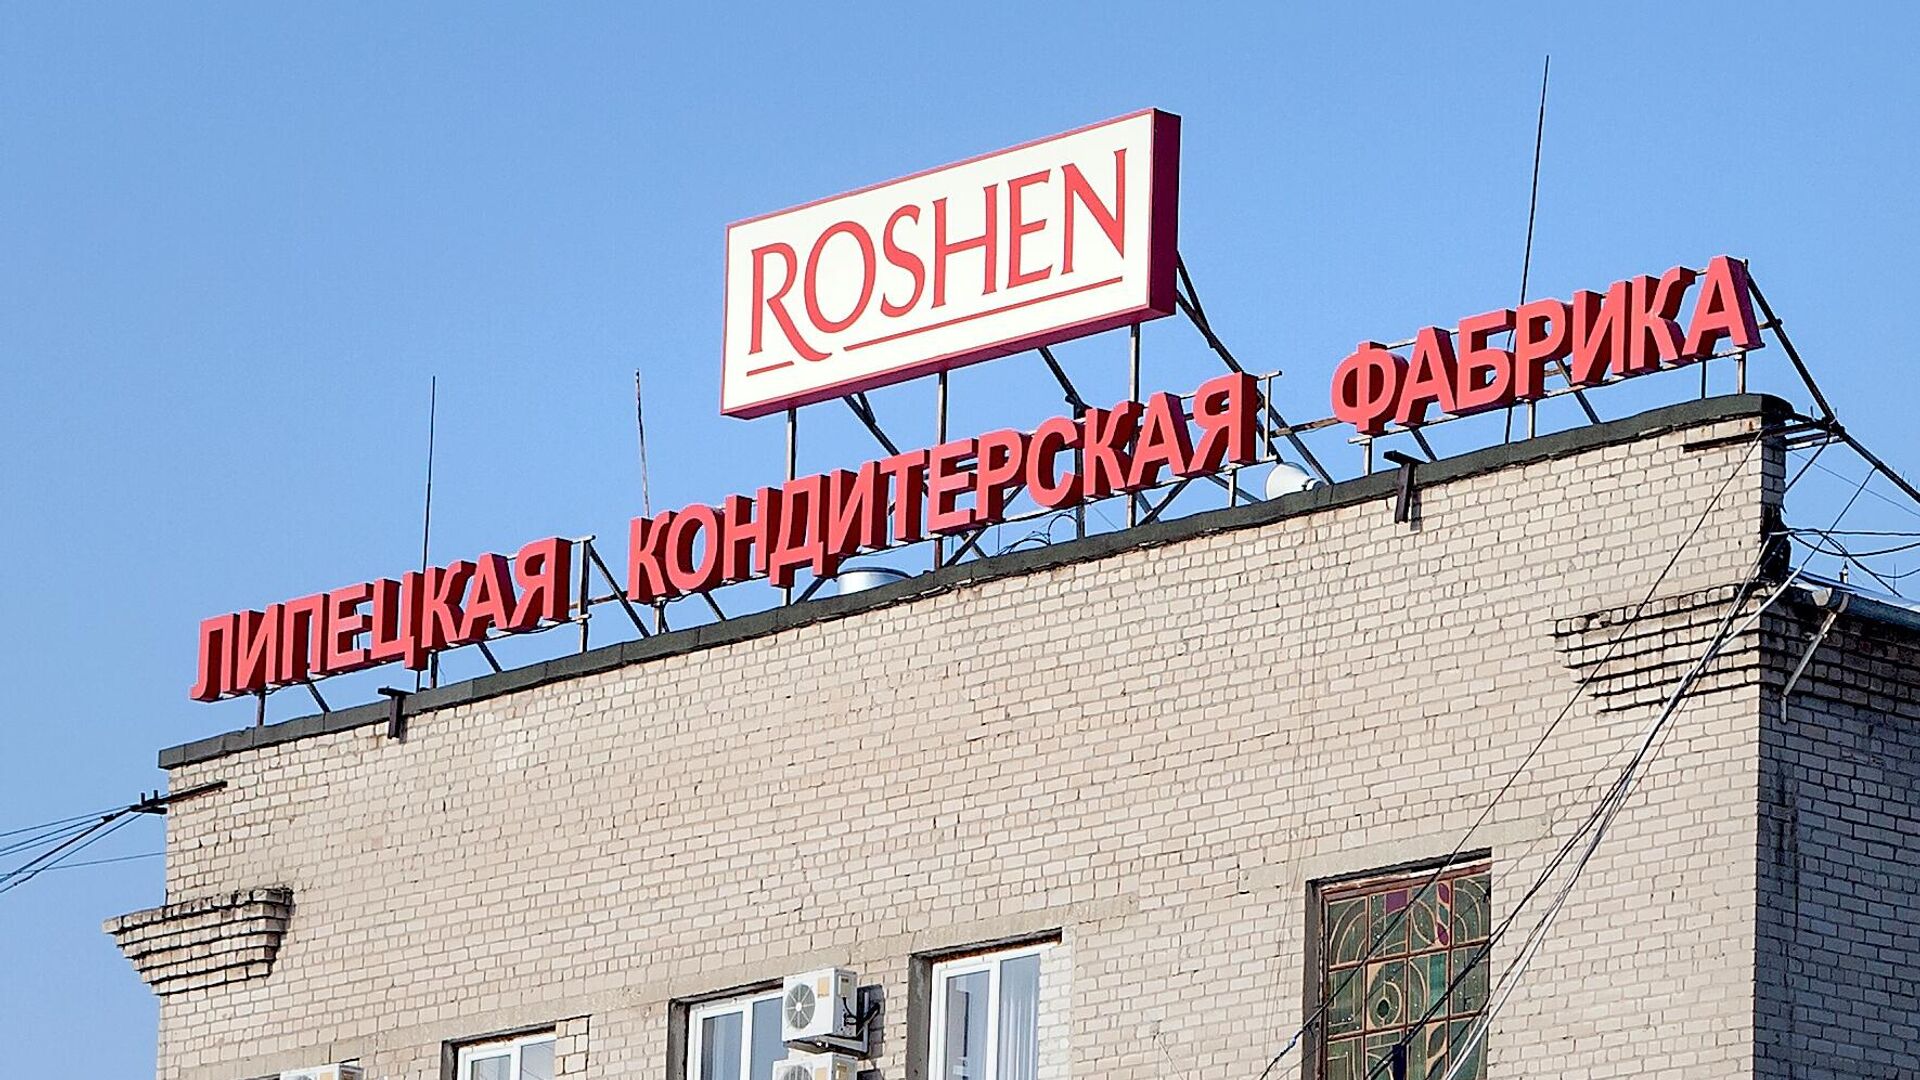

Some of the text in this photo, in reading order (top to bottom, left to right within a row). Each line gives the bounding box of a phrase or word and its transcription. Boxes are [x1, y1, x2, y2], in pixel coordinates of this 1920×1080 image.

[748, 148, 1128, 362] ROSHEN
[190, 256, 1763, 702] ЛИПЕЦКАЯ КОНДИТЕРСКАЯ ФАБРИКА
